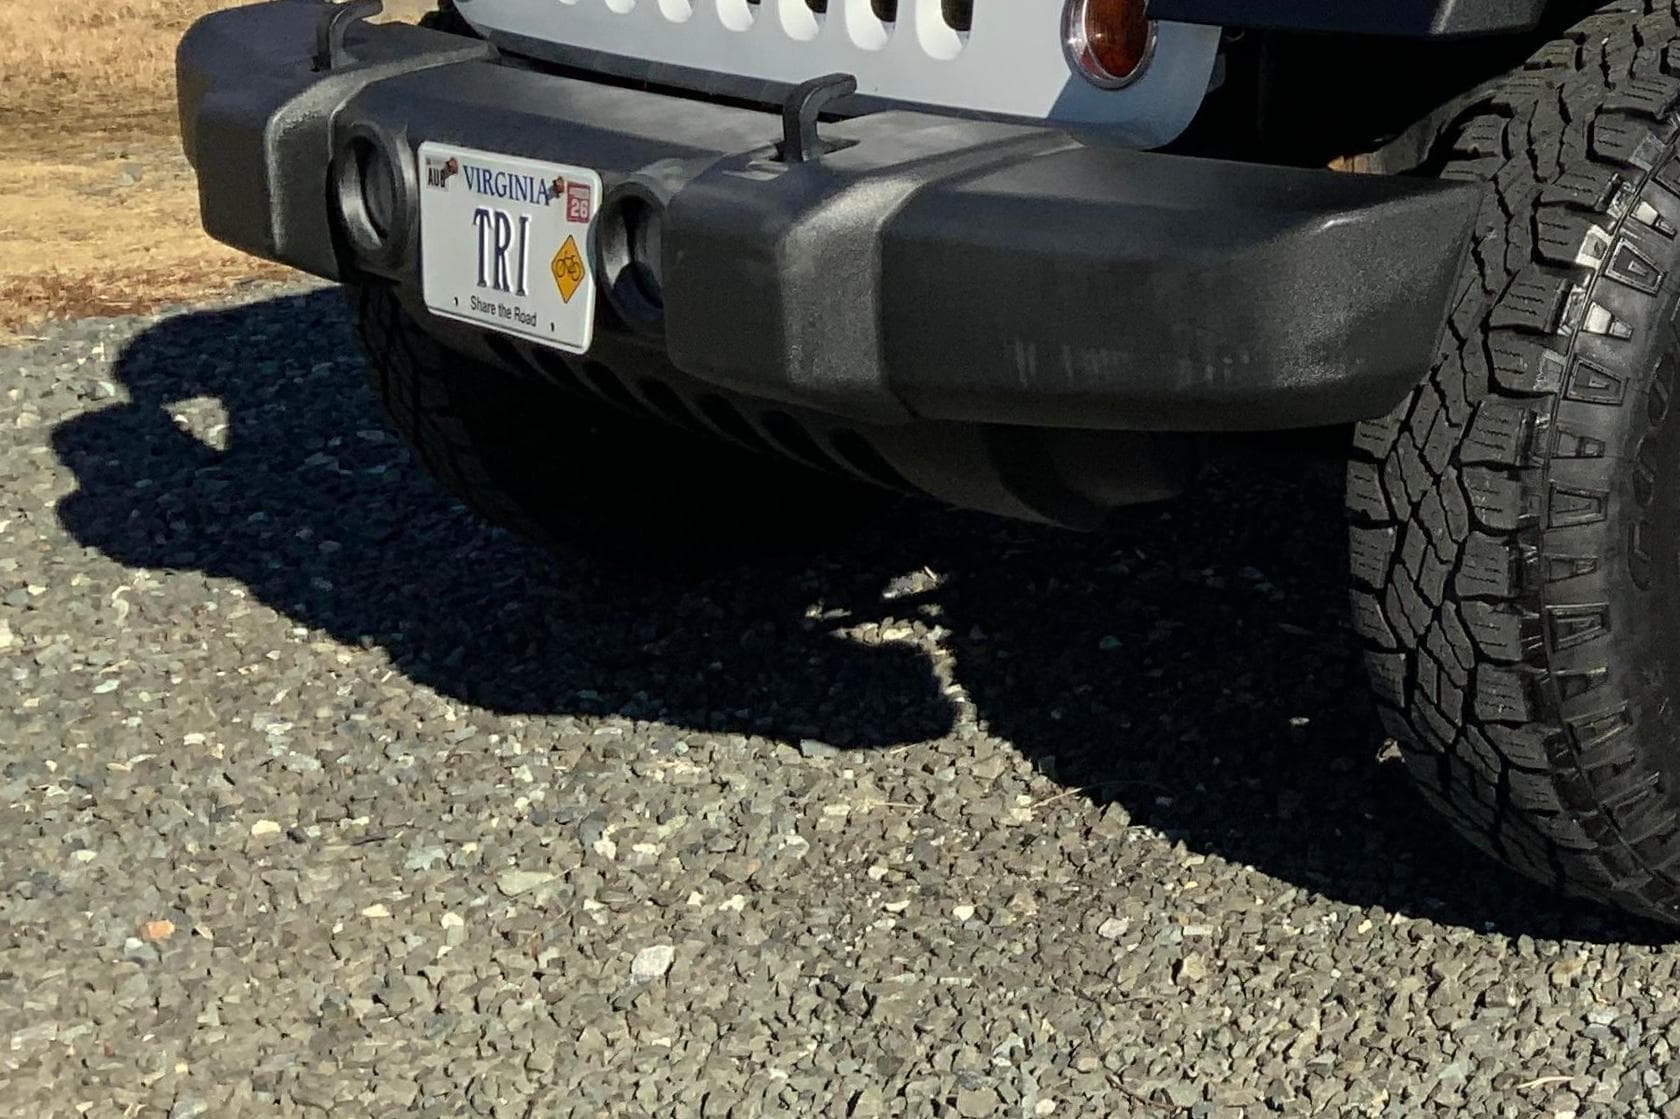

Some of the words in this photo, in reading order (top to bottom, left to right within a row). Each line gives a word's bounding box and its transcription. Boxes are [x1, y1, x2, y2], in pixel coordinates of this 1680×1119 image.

[462, 165, 552, 206] VIRGINIA
[570, 198, 588, 219] 26
[473, 207, 530, 298] TRI
[470, 295, 496, 316] Share
[498, 302, 512, 320] the
[514, 306, 537, 327] Road
